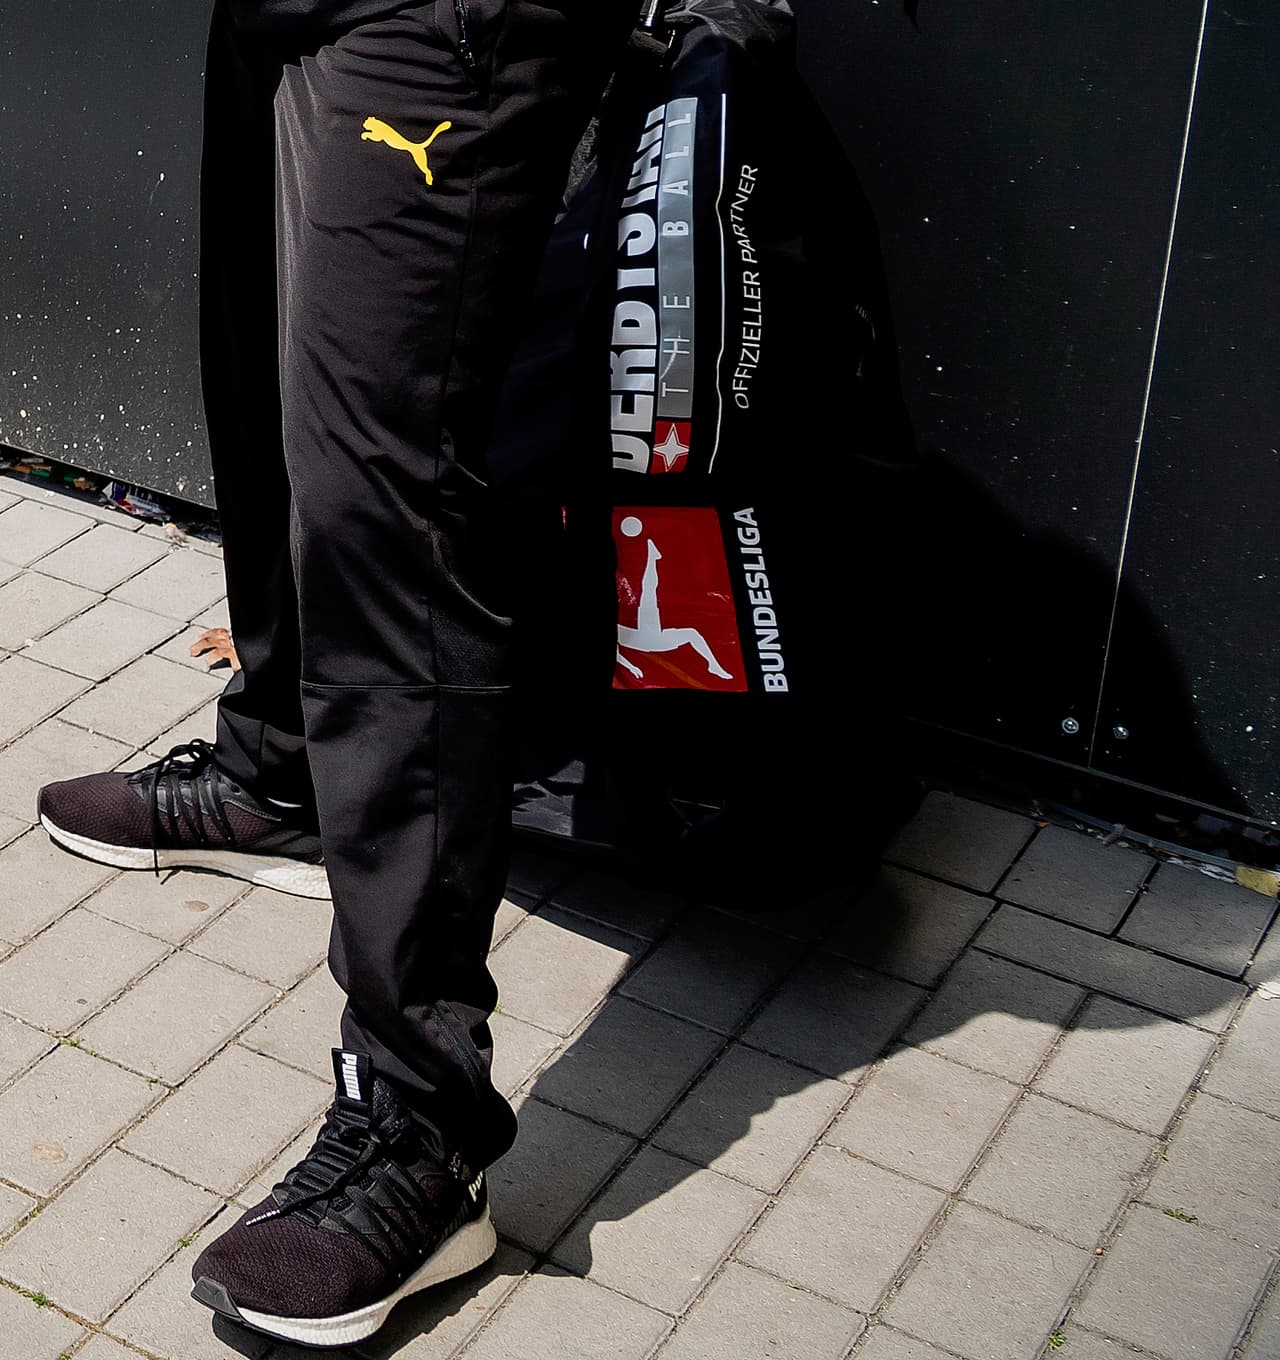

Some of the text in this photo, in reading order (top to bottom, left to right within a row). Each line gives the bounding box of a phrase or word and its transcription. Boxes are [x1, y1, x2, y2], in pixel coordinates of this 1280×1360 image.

[661, 111, 693, 398] THE BALL
[728, 163, 765, 410] OFFIZIELLER PARTNER
[733, 507, 790, 695] BUNDESLIGA
